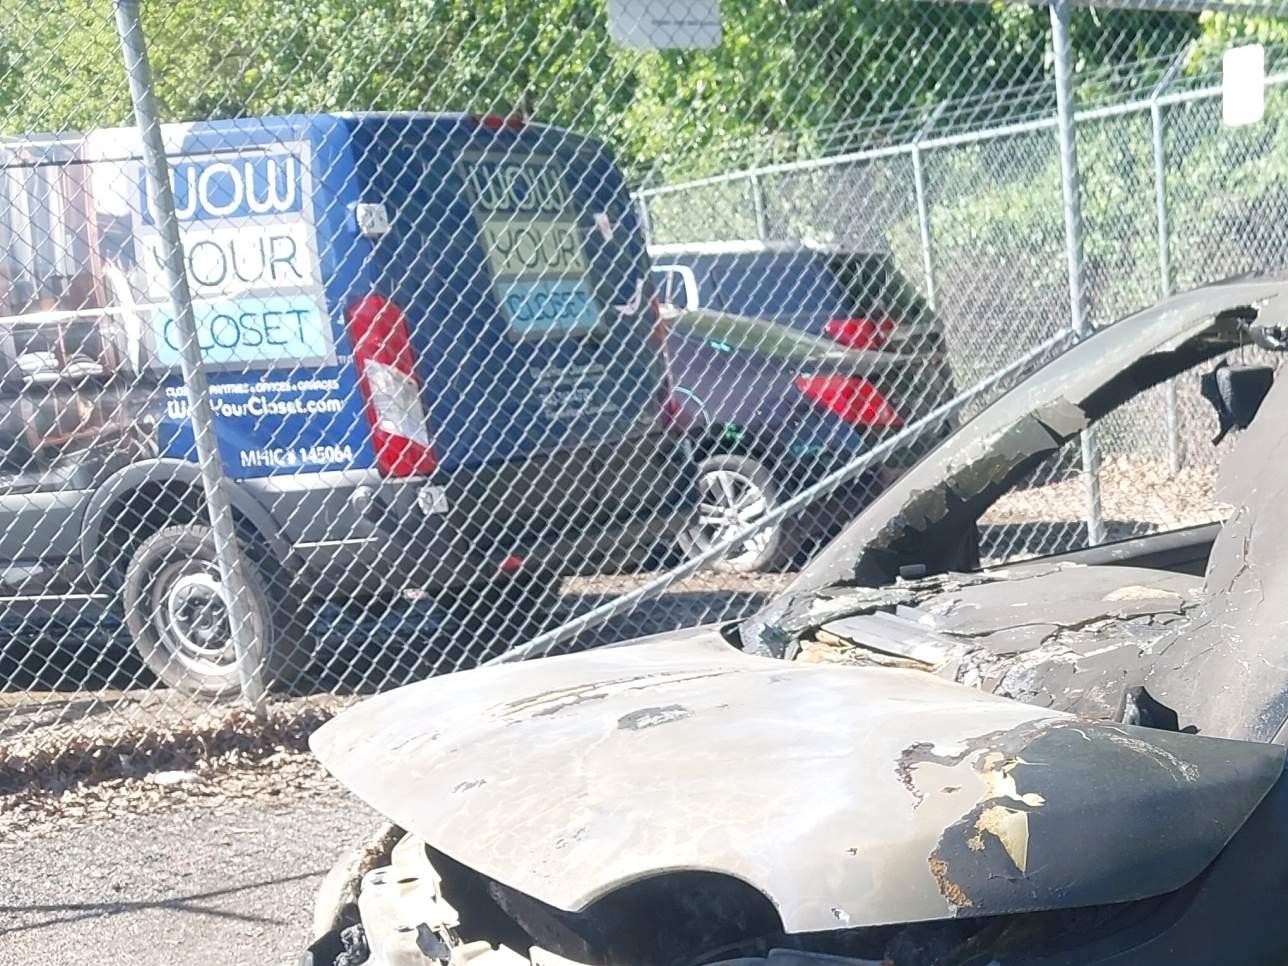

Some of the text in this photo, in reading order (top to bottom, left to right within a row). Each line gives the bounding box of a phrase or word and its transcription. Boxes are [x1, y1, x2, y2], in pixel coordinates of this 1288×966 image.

[469, 165, 565, 211] WOW
[490, 228, 581, 269] YOUR
[299, 445, 353, 464] 145064
